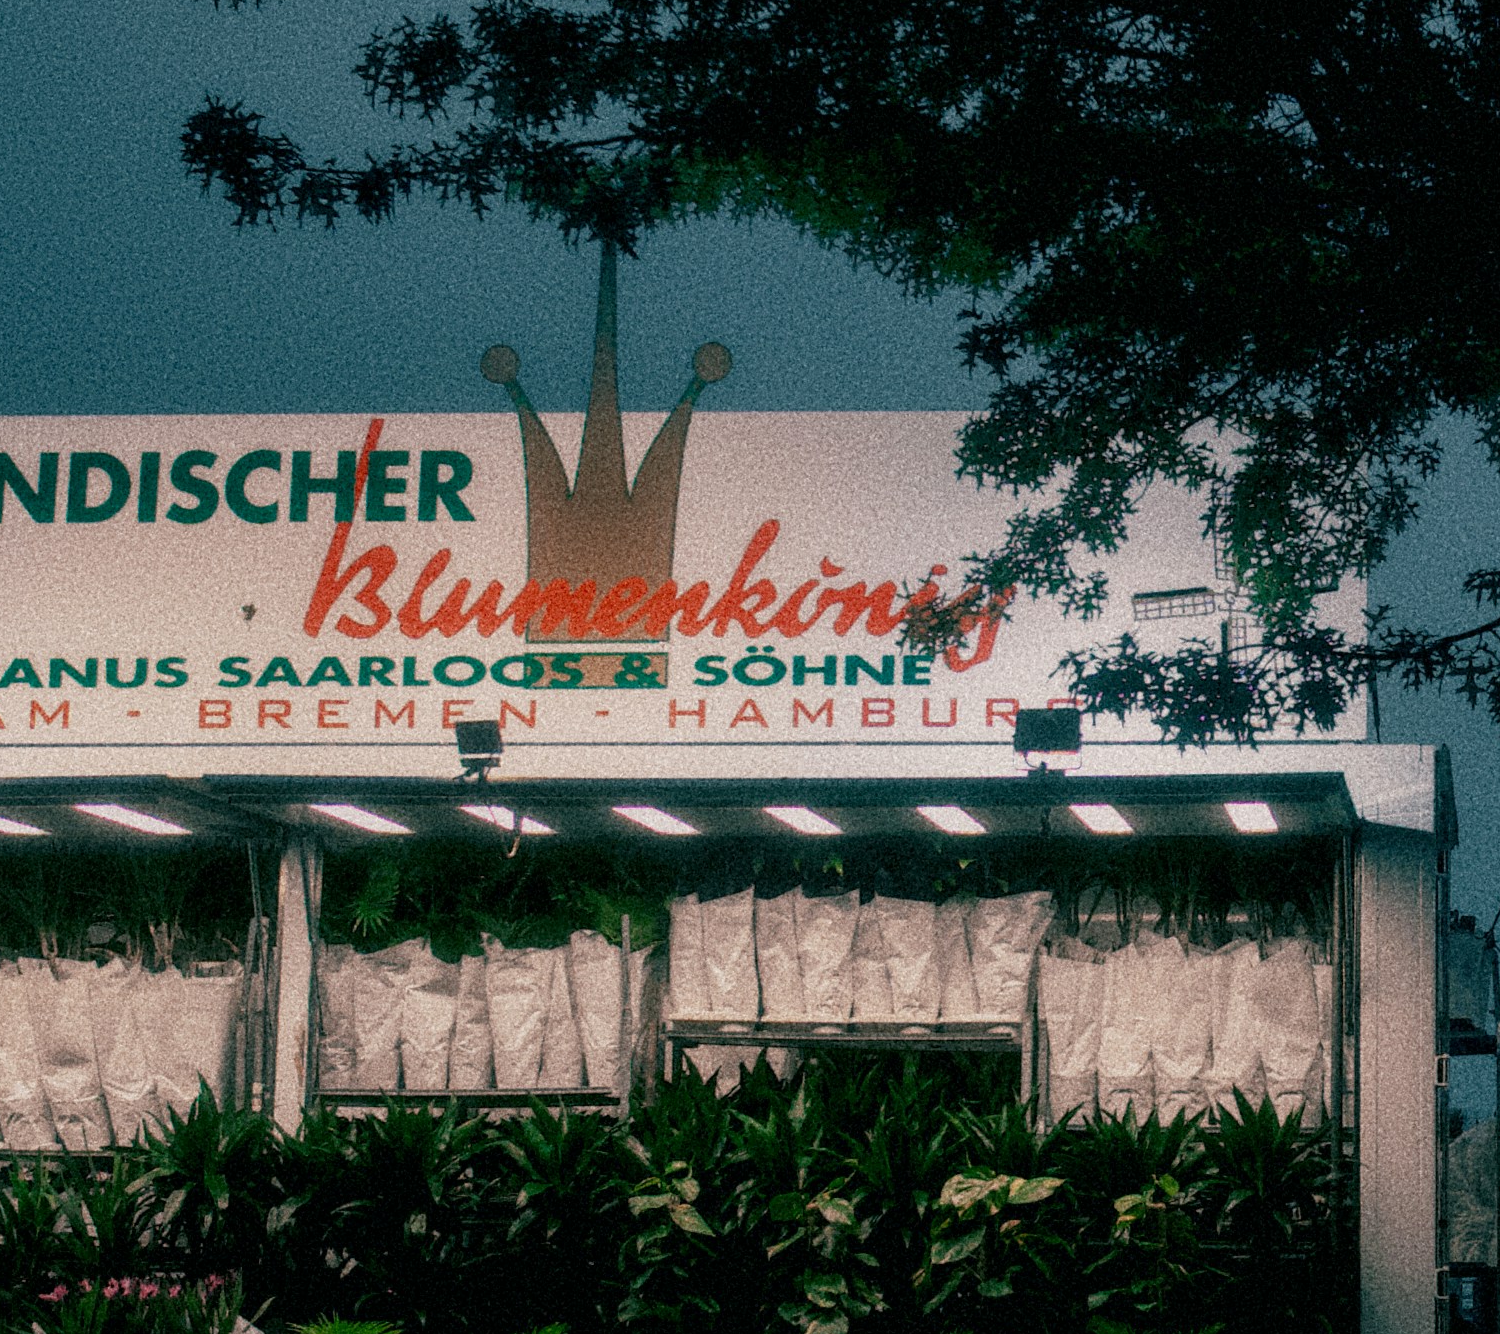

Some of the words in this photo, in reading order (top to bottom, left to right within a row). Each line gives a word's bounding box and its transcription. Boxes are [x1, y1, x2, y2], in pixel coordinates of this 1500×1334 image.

[303, 418, 1016, 673] Blumenkönig
[218, 654, 583, 689] SAARLOOS
[614, 654, 660, 688] &
[693, 645, 934, 687] SÖHNE
[198, 699, 538, 730] BREMEN
